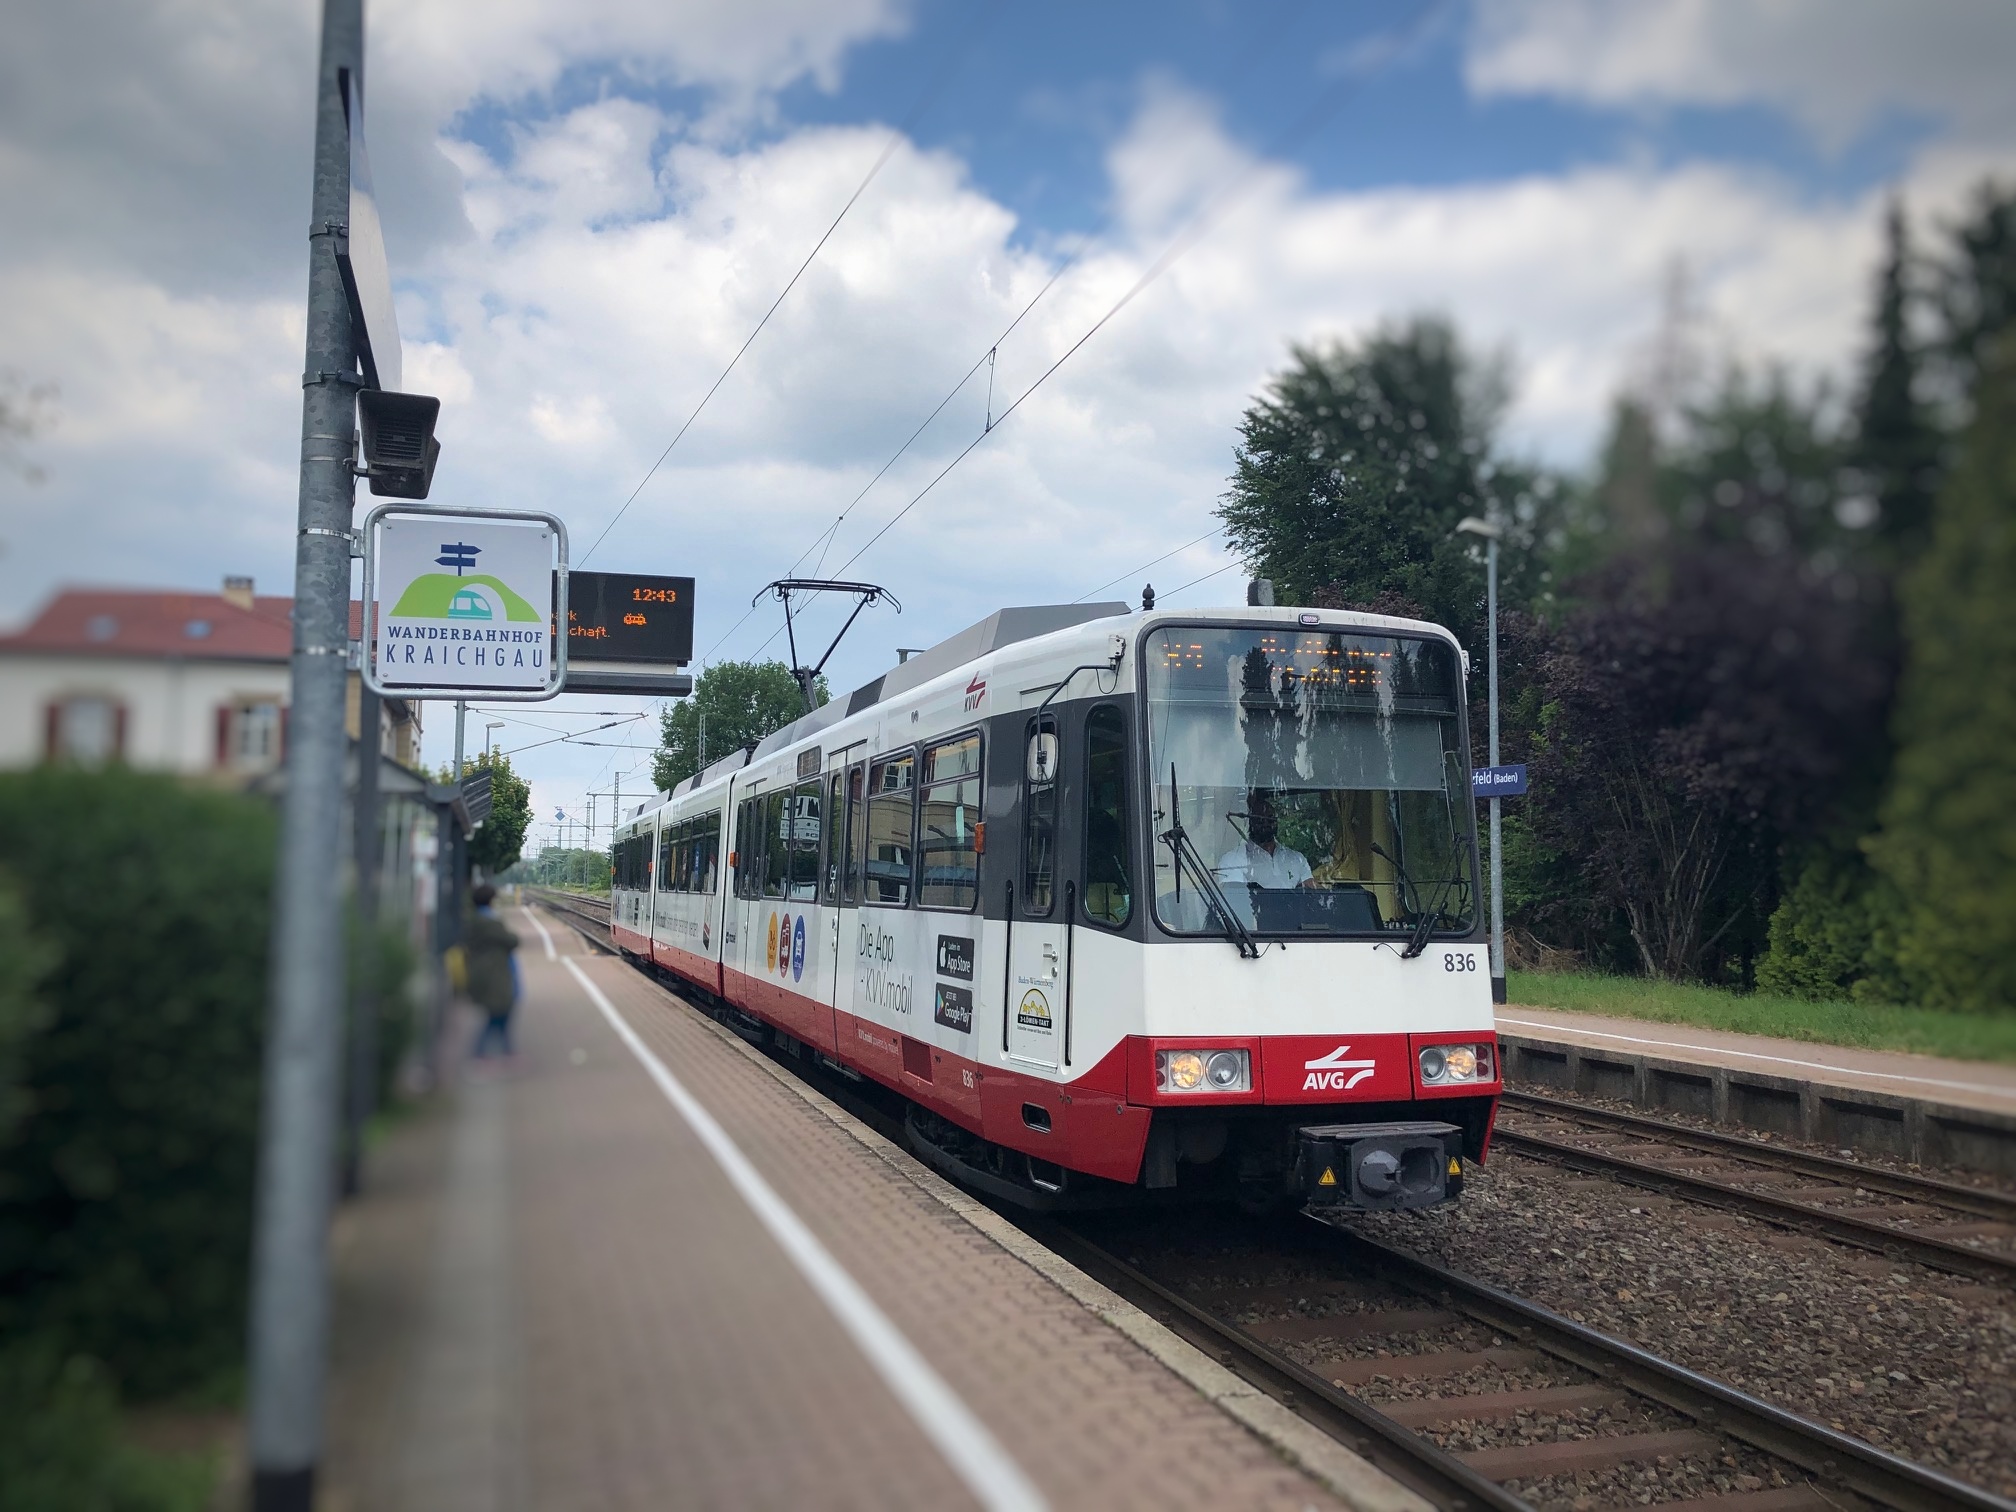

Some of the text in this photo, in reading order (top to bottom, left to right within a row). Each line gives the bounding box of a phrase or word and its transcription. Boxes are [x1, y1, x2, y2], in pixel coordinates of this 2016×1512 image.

[633, 588, 676, 602] 12:43
[387, 626, 543, 643] WANDERBAHNHOF
[386, 644, 543, 668] KRAICHGAU
[1493, 772, 1519, 786] (Baden)
[860, 922, 894, 972] Die App
[946, 953, 971, 974] App Store
[1443, 953, 1476, 972] 836
[944, 1002, 960, 1024] Google
[962, 1069, 974, 1089] 836
[1302, 1071, 1345, 1091] AVG
